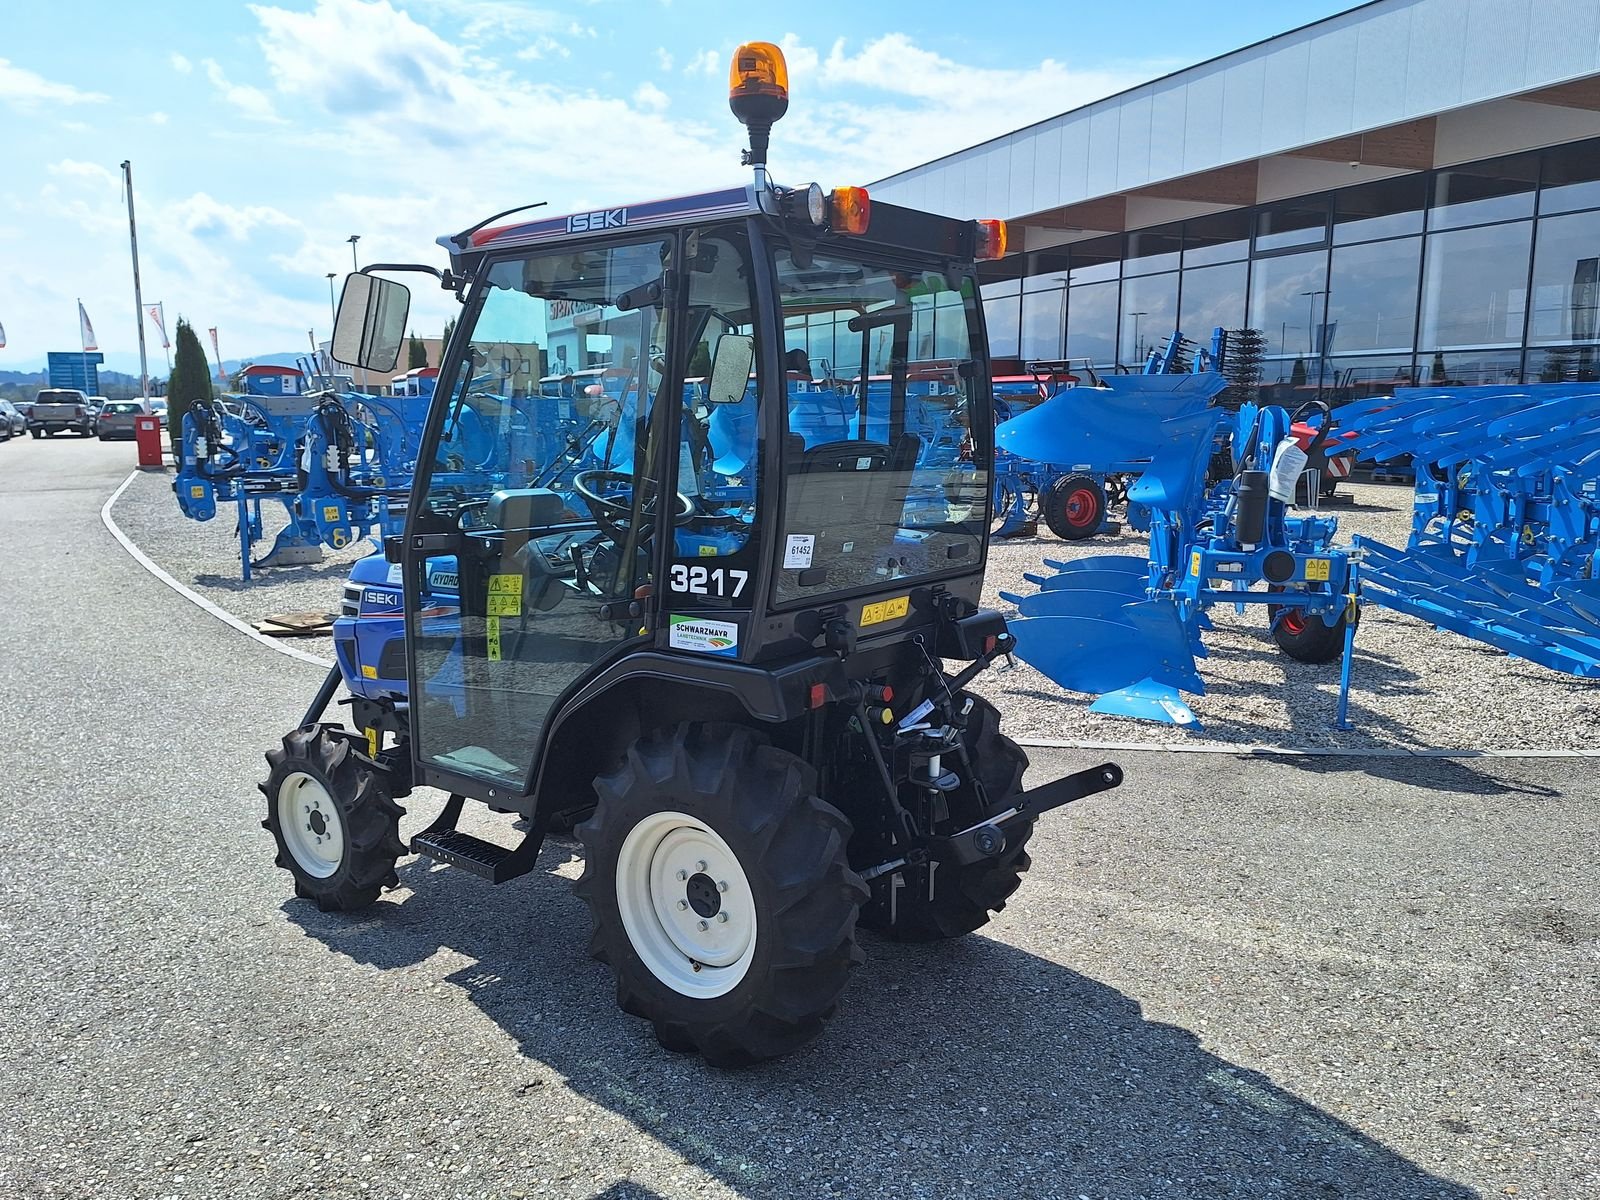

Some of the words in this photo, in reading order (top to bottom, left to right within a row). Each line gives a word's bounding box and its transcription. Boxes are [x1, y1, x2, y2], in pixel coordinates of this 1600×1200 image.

[567, 208, 627, 233] ISEKI
[791, 545, 811, 555] 61452
[670, 564, 748, 598] 3217
[365, 591, 397, 605] ISEKI
[676, 624, 728, 638] SCHWARZMAYR
